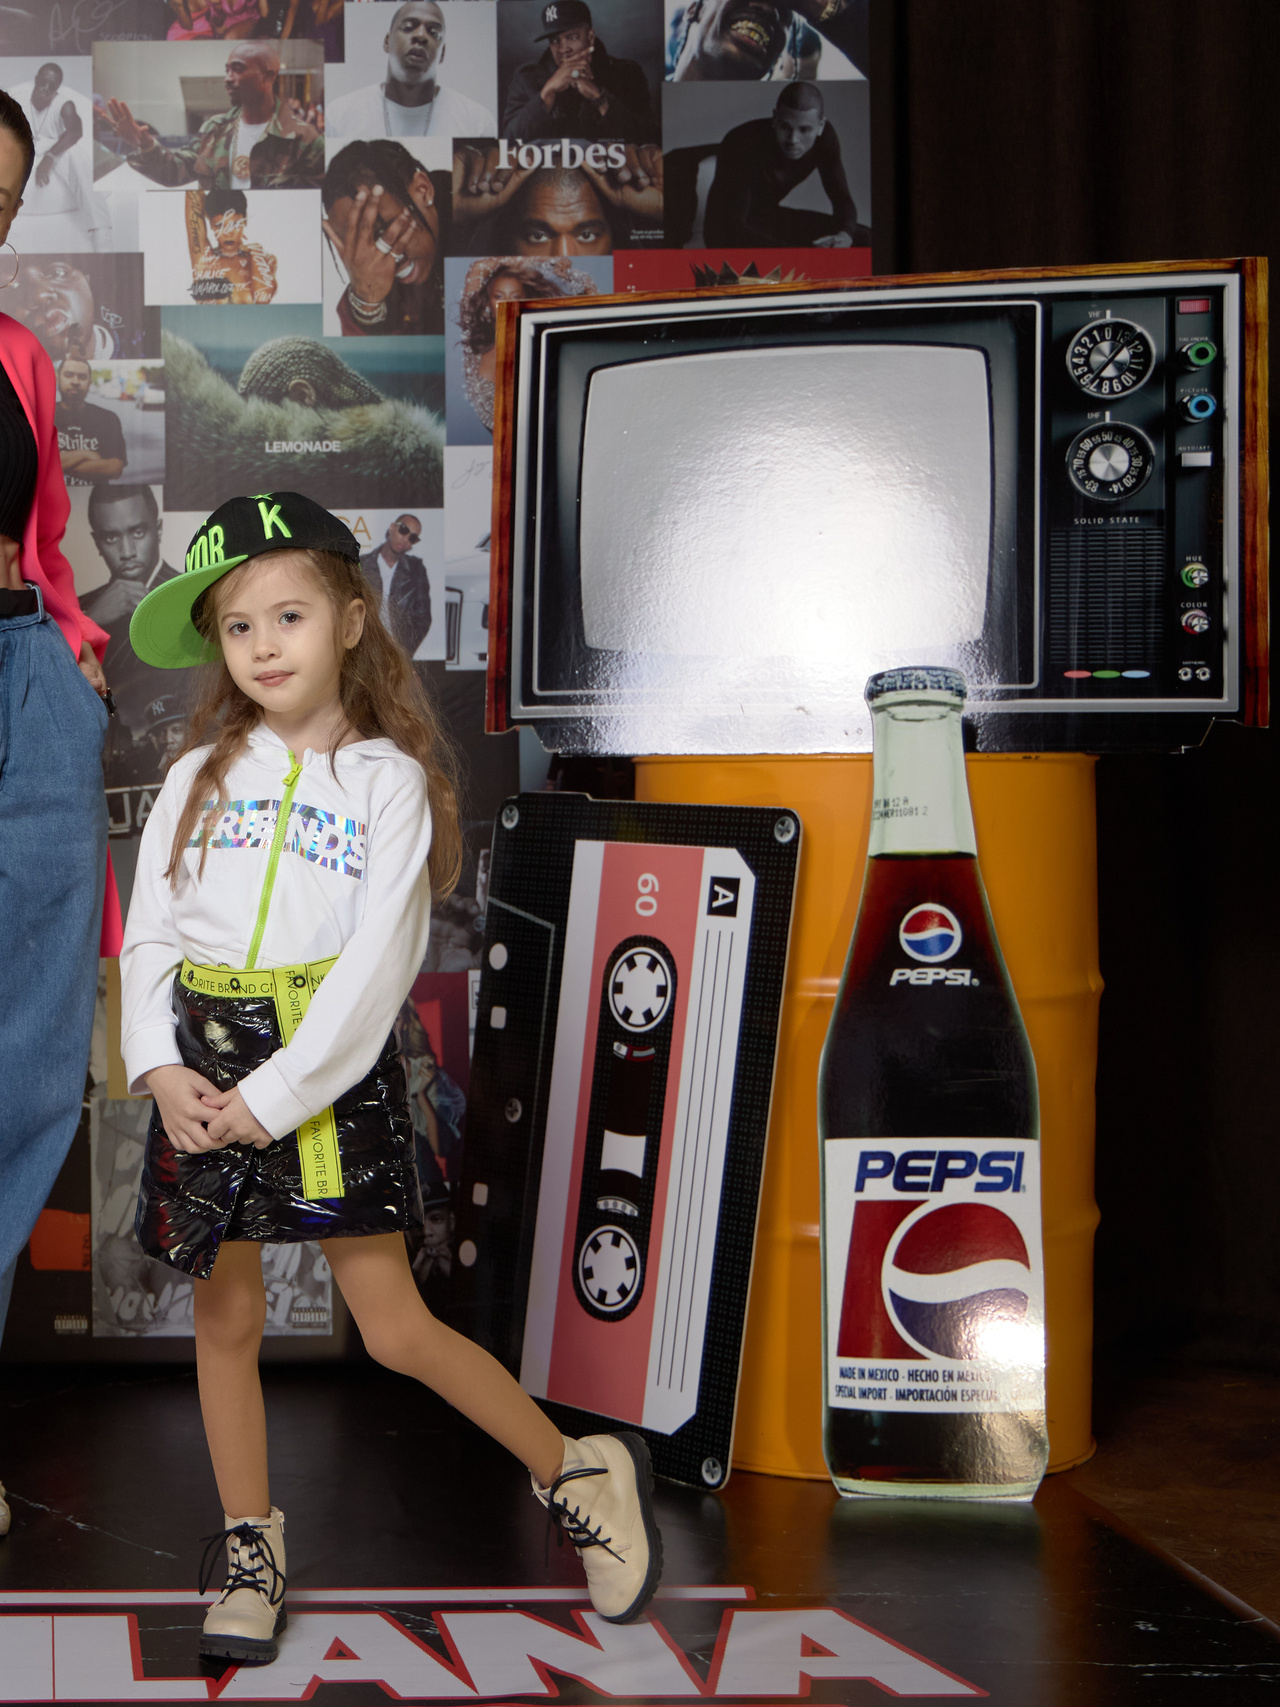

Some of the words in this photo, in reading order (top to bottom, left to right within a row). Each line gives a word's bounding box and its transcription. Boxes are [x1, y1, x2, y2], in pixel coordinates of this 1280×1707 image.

[495, 138, 627, 170] Forbes
[1092, 330, 1100, 342] 1
[1104, 327, 1112, 340] 0
[1081, 336, 1094, 348] 2
[1128, 340, 1143, 355] 12
[1074, 346, 1088, 355] 3
[1072, 357, 1085, 365] 4
[1074, 366, 1088, 376] 5
[1080, 373, 1093, 385] 6
[1089, 378, 1099, 392] 7
[1112, 379, 1122, 392] 9
[1121, 372, 1136, 387] 10
[1102, 380, 1109, 394] 8
[1101, 431, 1113, 441] 50
[1122, 437, 1135, 448] 40
[265, 440, 341, 453] LEMONADE
[1080, 438, 1093, 451] 60
[1073, 459, 1084, 470] 70
[1132, 455, 1143, 467] 30
[1122, 474, 1136, 488] 20
[258, 502, 292, 540] K
[635, 873, 659, 917] 60
[712, 884, 734, 908] A
[285, 970, 303, 1024] FAVORITE
[310, 1121, 327, 1177] FAVORITE
[854, 1150, 1024, 1193] PEPSI
[839, 1366, 856, 1380] MADE
[858, 1367, 866, 1380] IN
[868, 1368, 899, 1382] MEXICO
[907, 1369, 939, 1383] HECHO
[942, 1369, 954, 1383] EN
[835, 1385, 856, 1398] SPECIAL
[858, 1386, 887, 1400] IMPORT
[895, 1385, 958, 1402] IMPORTACIÓN
